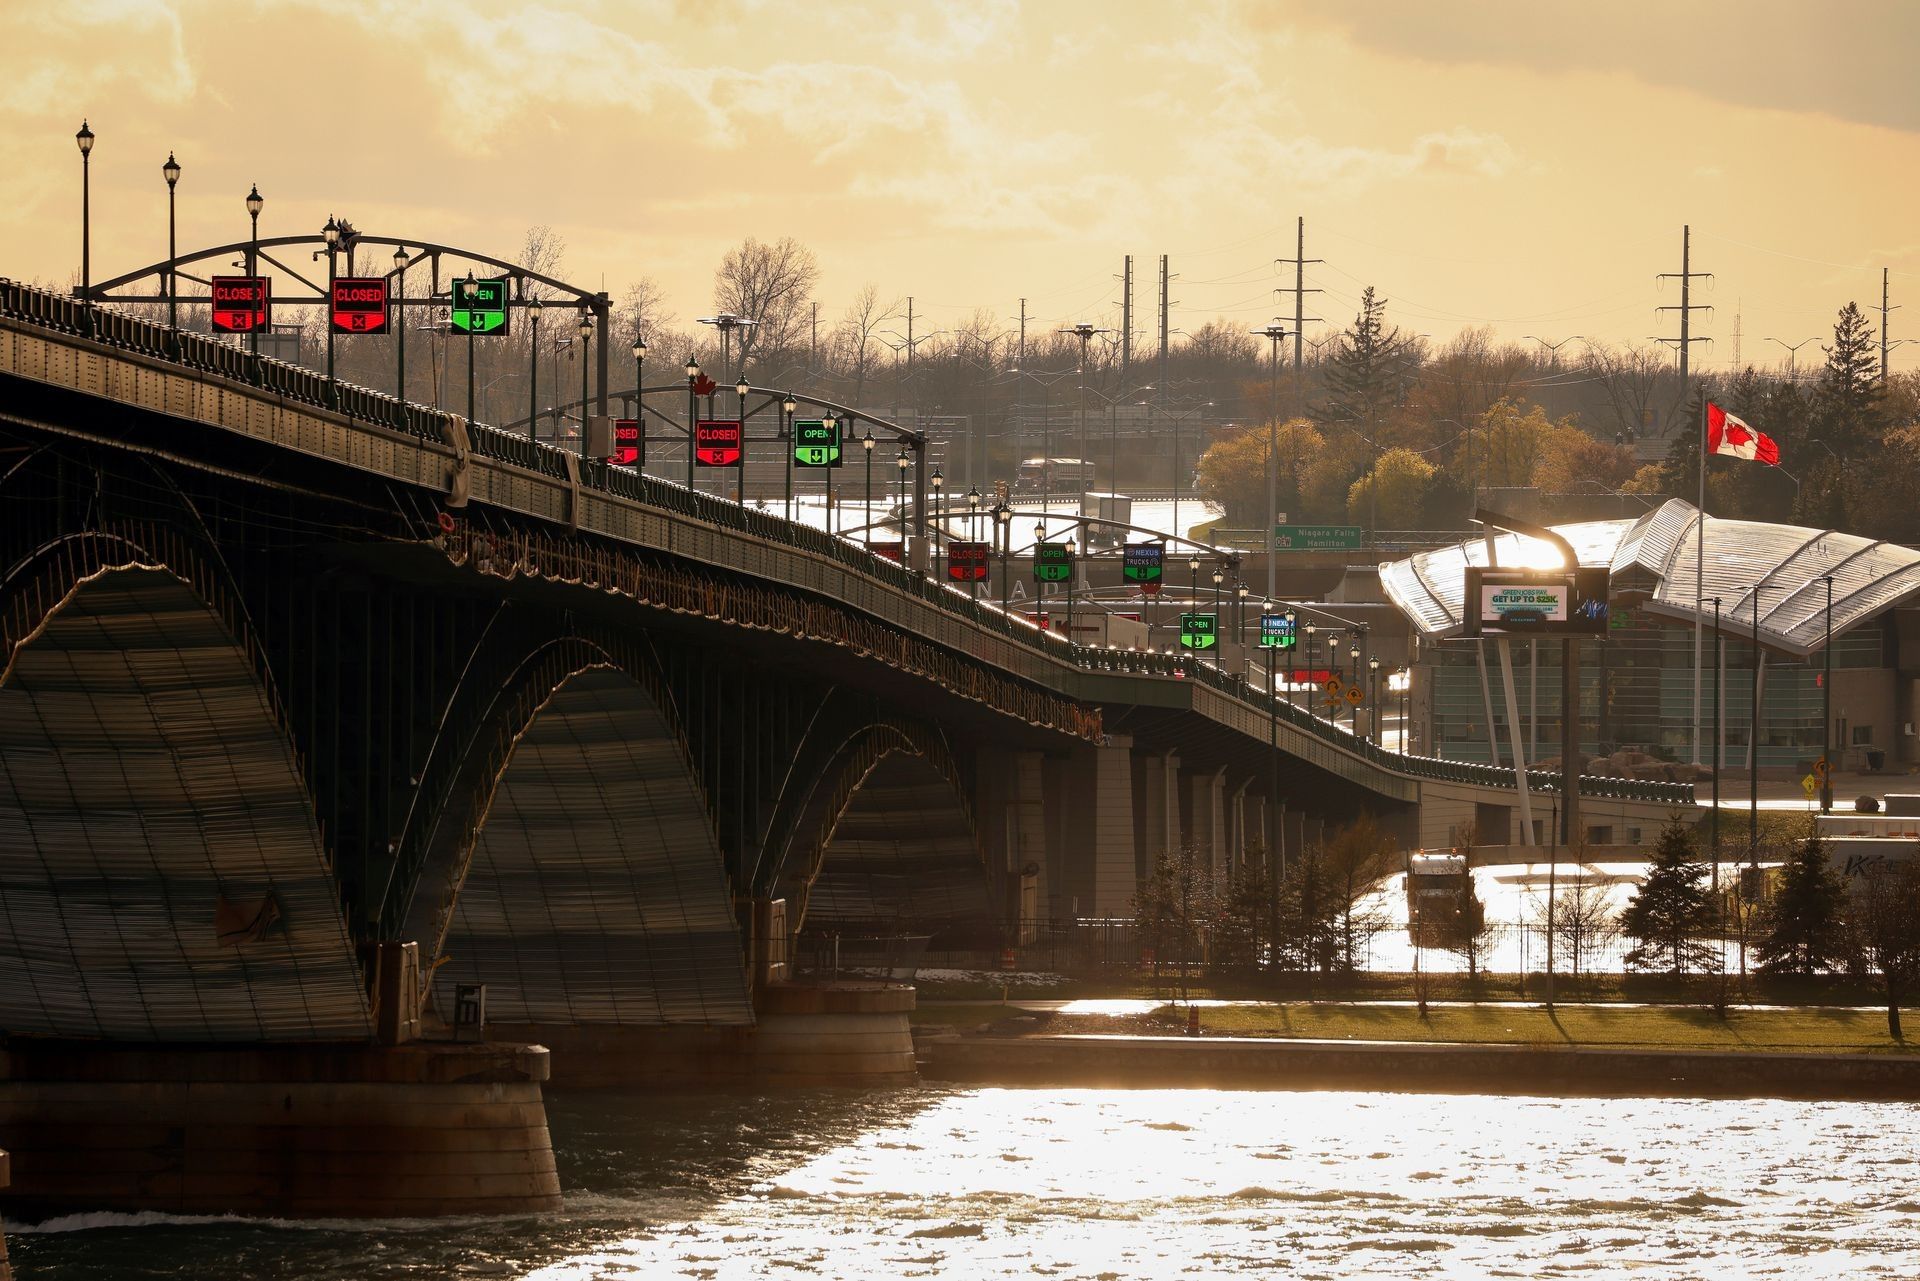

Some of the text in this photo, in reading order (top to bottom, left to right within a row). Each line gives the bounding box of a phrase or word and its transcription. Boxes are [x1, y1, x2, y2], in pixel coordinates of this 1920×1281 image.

[217, 288, 262, 300] CLOSED
[336, 289, 382, 302] CLOSED
[614, 429, 638, 439] OSED
[700, 429, 737, 440] CLOSED
[1298, 529, 1355, 538] Niagara Falls
[880, 549, 898, 559] SED
[1042, 550, 1064, 558] OPEN
[1493, 595, 1558, 603] GET UP TO $25K.
